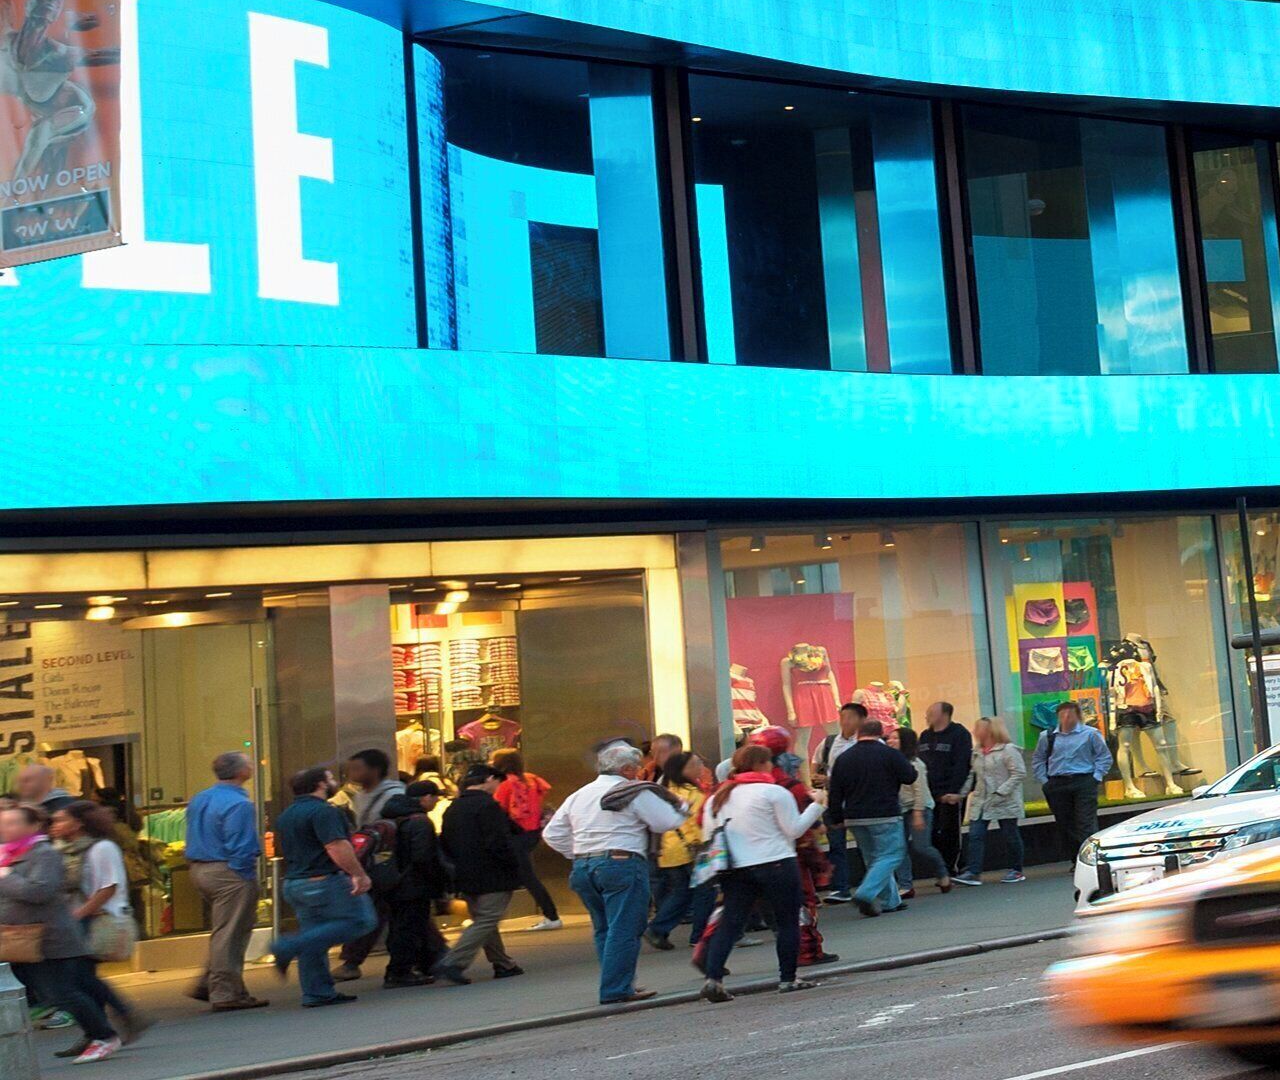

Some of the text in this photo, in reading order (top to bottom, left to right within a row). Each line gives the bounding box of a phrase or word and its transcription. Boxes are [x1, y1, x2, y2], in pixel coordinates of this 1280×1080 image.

[0, 161, 111, 198] NOW OPEN
[42, 654, 94, 669] SECOND
